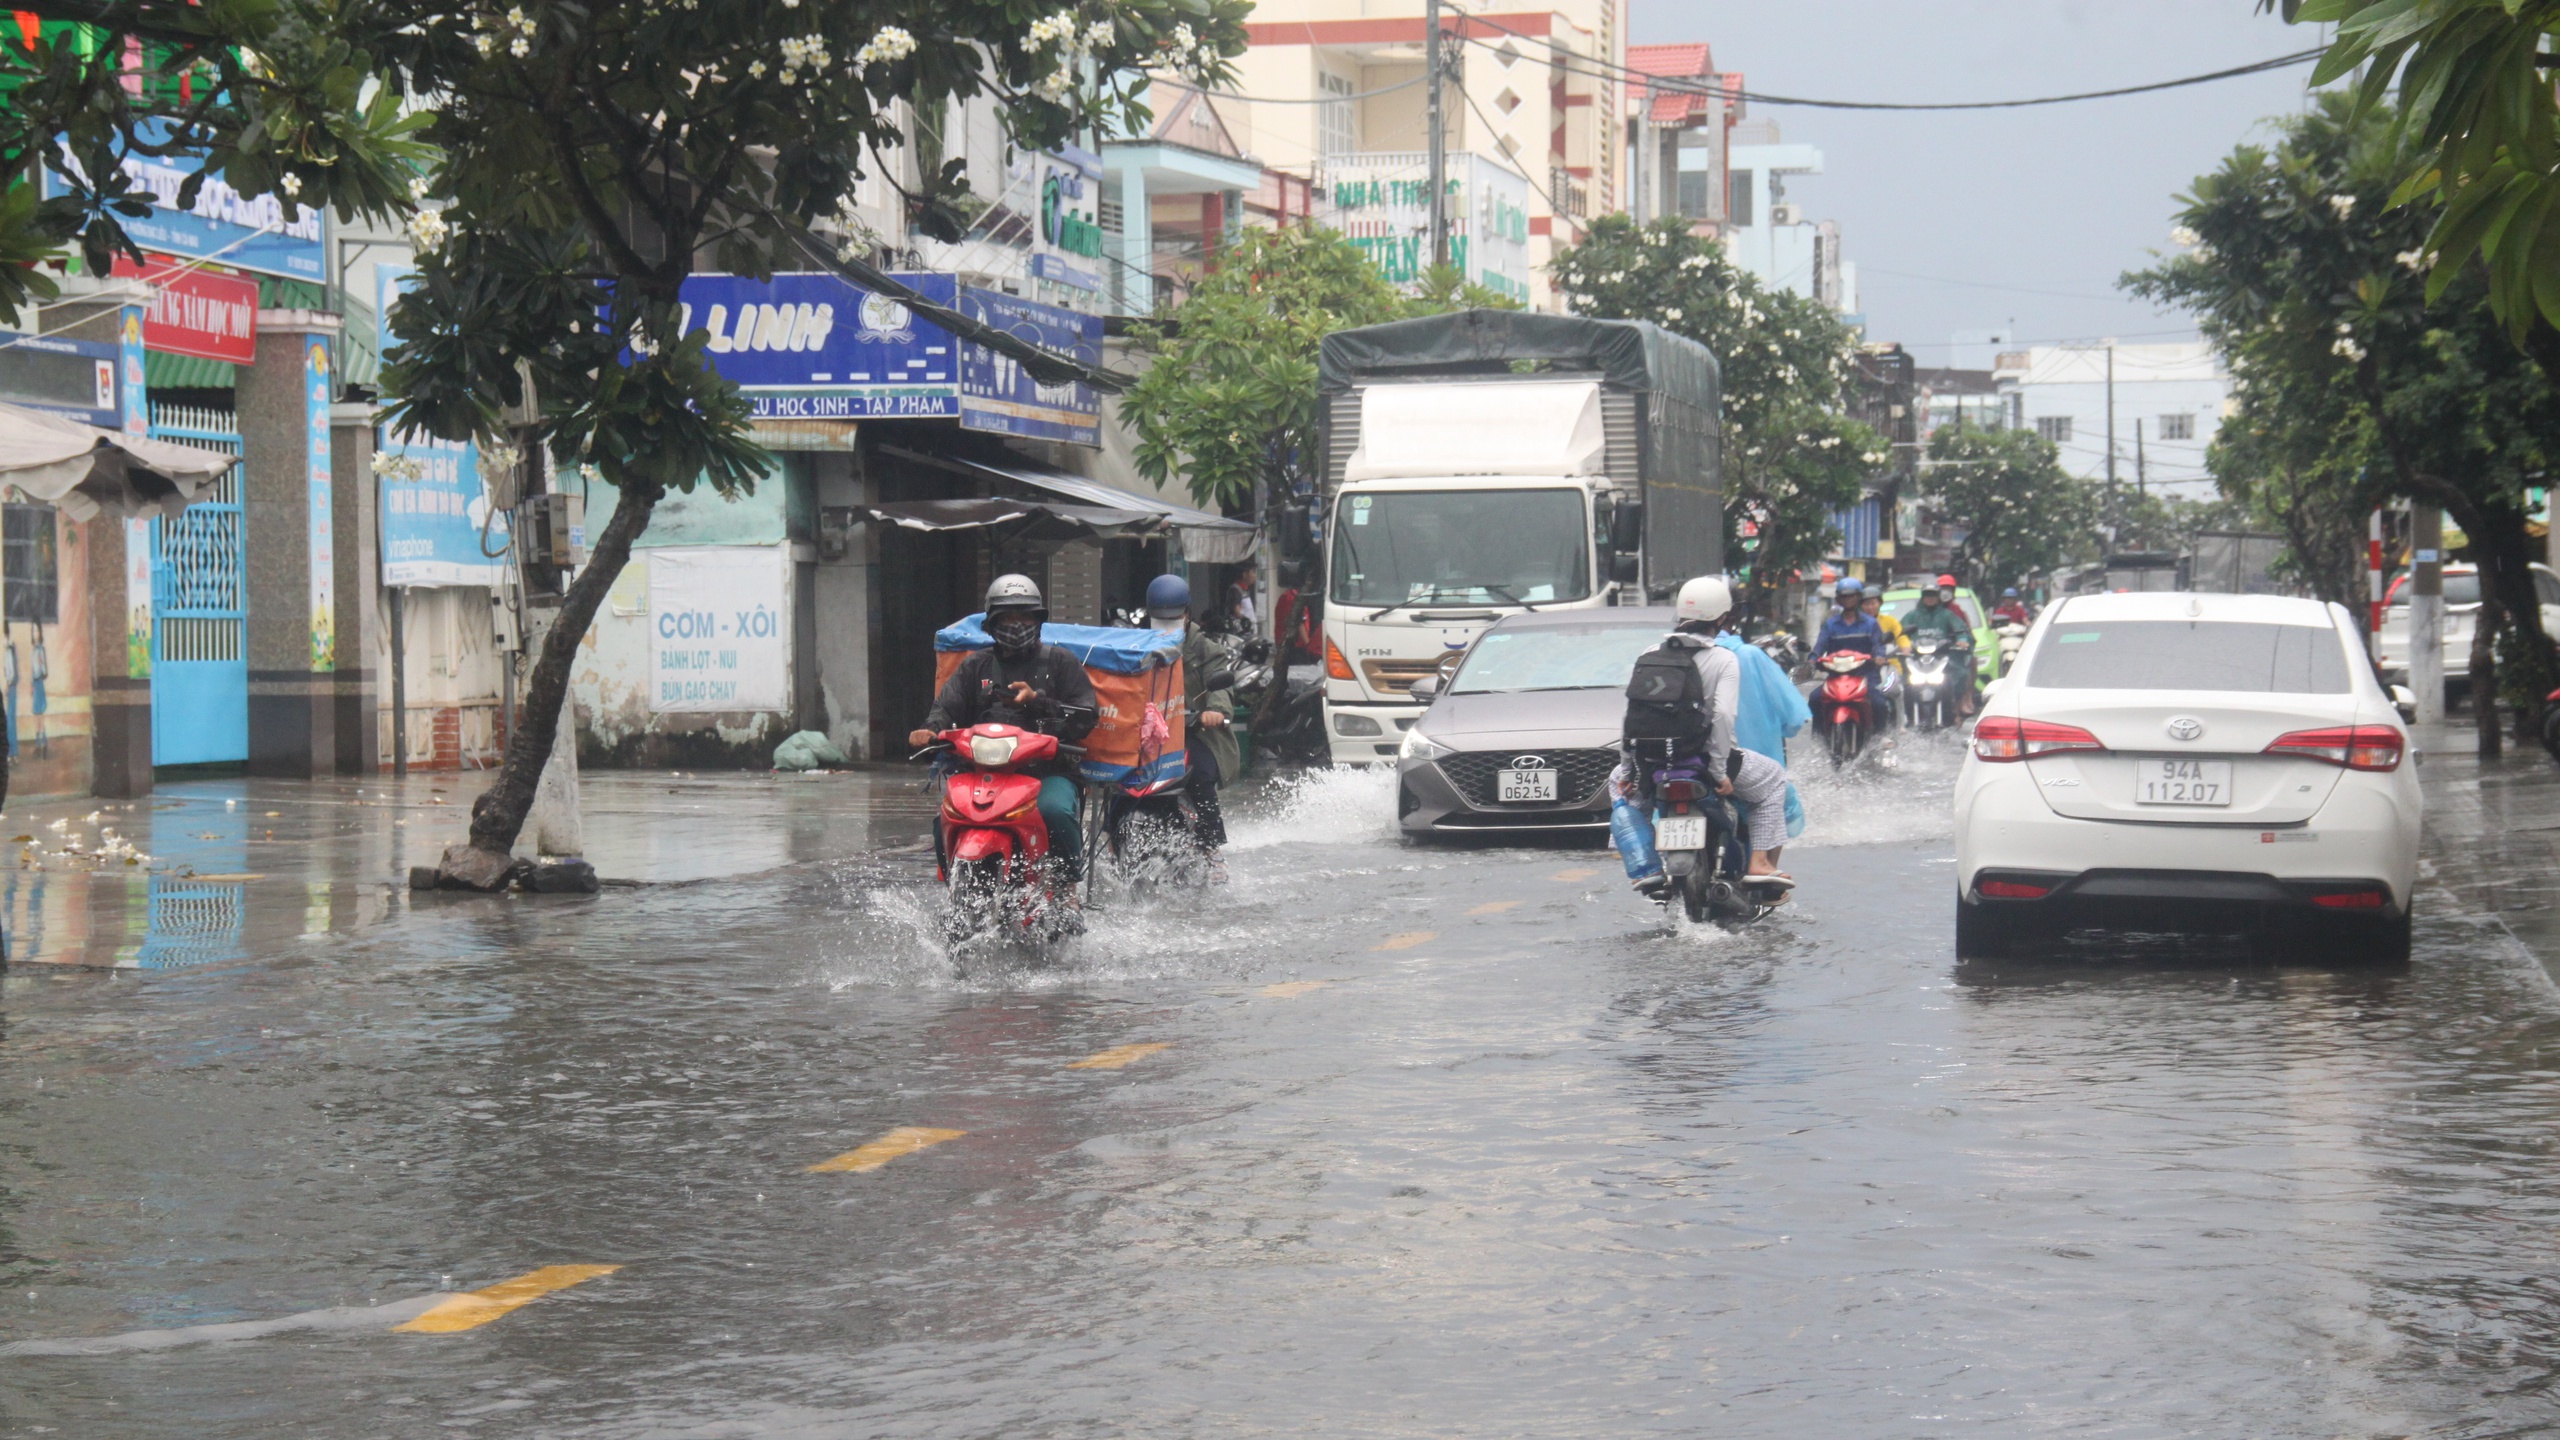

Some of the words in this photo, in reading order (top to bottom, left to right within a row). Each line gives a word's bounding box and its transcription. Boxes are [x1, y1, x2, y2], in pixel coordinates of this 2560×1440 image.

[181, 286, 207, 332] NĂM
[207, 298, 229, 344] HỌC
[704, 303, 834, 353] LINH
[813, 397, 849, 415] SINH
[388, 534, 434, 561] vinaphone
[659, 608, 714, 639] CƠM
[736, 603, 776, 638] XÔI
[661, 645, 689, 670] BÁNH
[719, 650, 737, 669] NUI
[661, 676, 682, 701] BÚN
[685, 681, 706, 706] GẠO
[709, 681, 736, 700] CHAY
[1515, 772, 1540, 785] 94A
[2163, 761, 2202, 780] 94A
[1505, 786, 1551, 799] 062.54
[2147, 782, 2219, 802] 112.07
[1663, 834, 1697, 848] 7104
